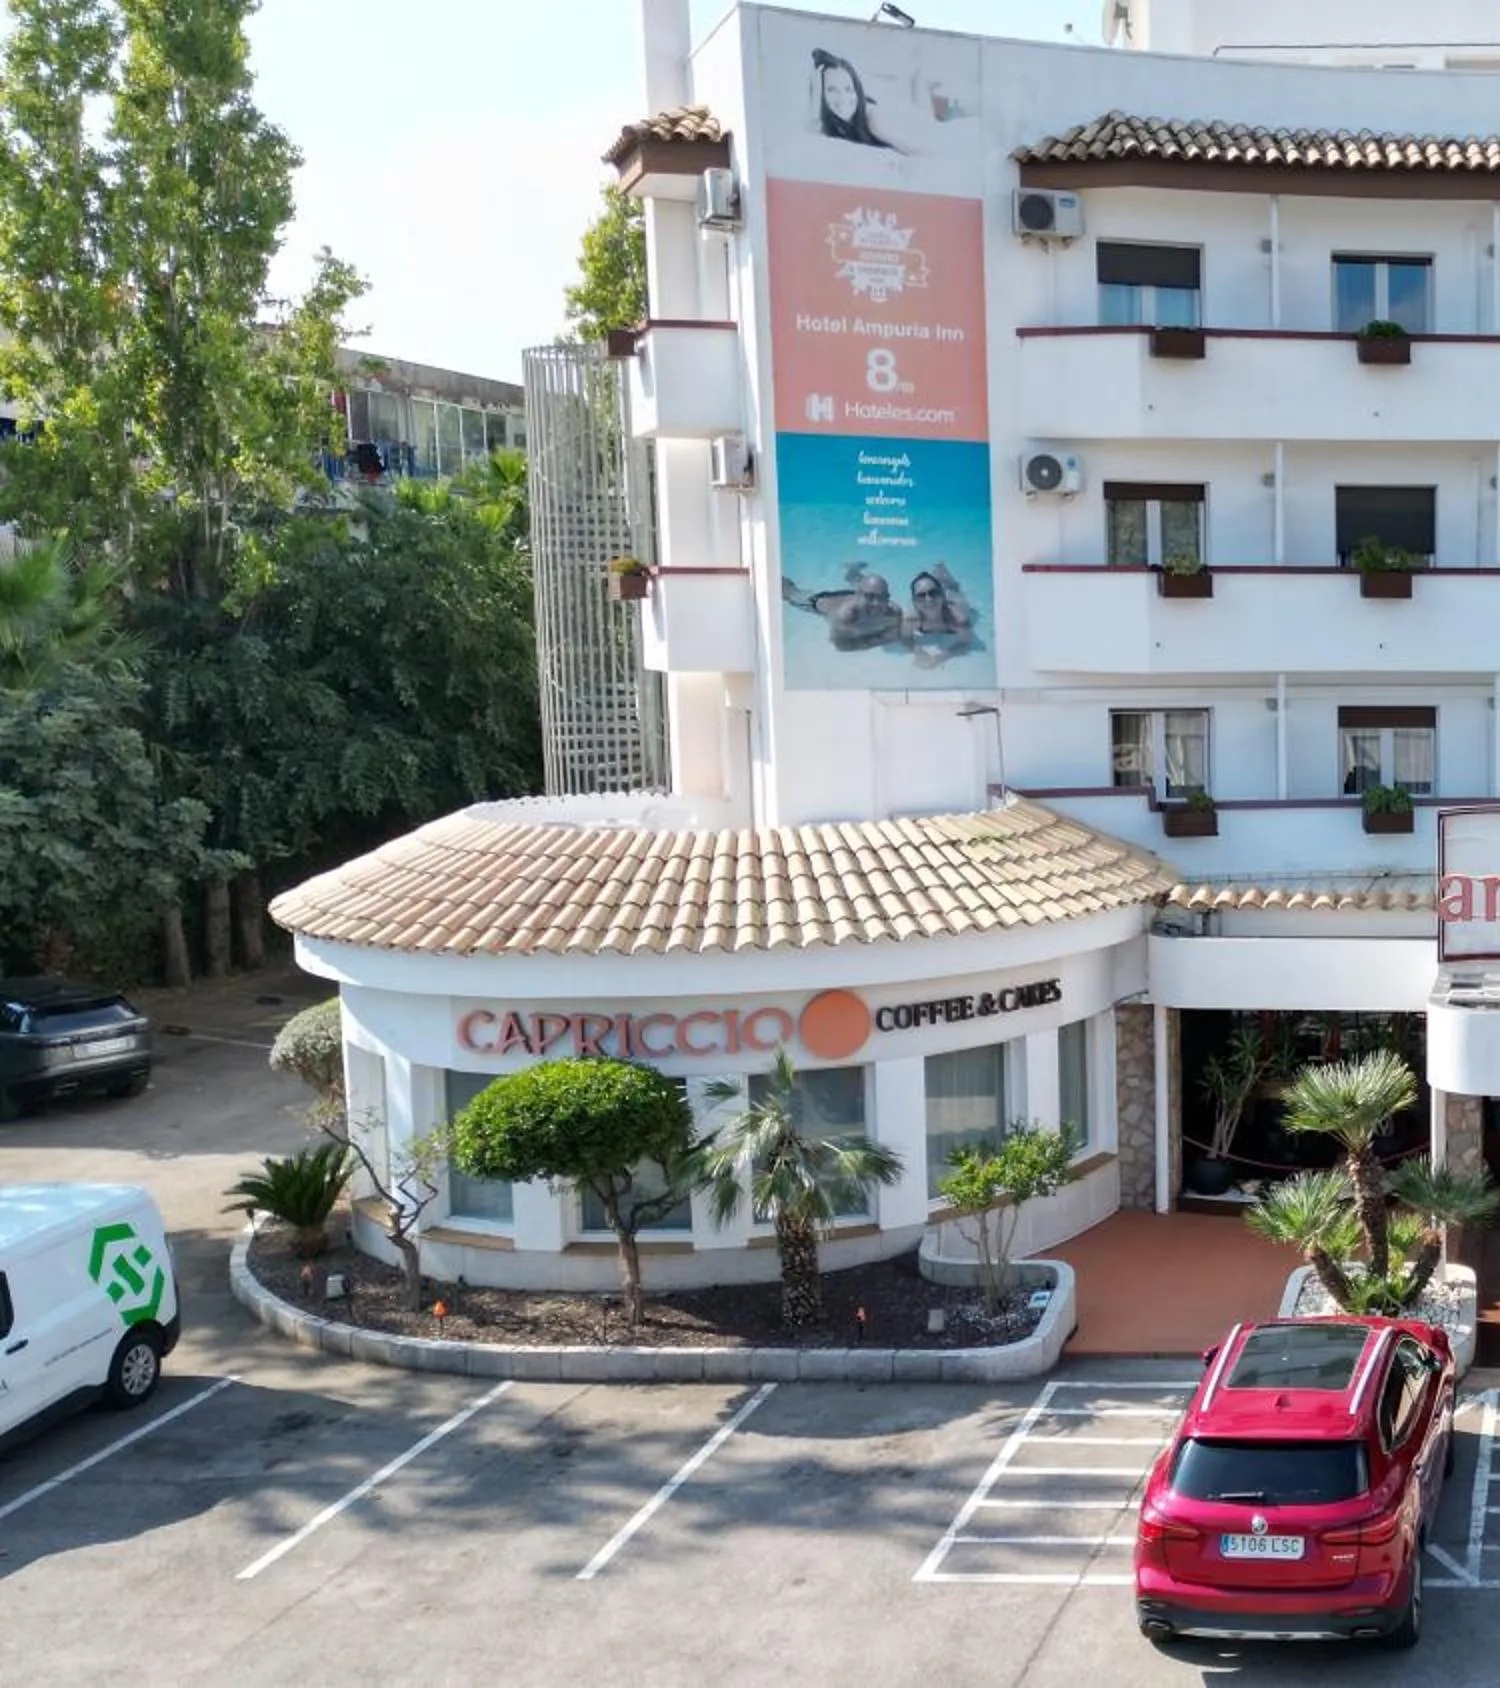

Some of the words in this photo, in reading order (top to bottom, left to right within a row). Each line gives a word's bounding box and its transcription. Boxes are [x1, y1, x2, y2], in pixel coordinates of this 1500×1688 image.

[796, 313, 847, 333] Hotel
[853, 318, 930, 340] Ampuria
[936, 324, 964, 341] Inn
[845, 402, 955, 423] Hoteles.com
[876, 995, 975, 1032] COFFEE
[457, 1007, 794, 1058] CAPRICCIO
